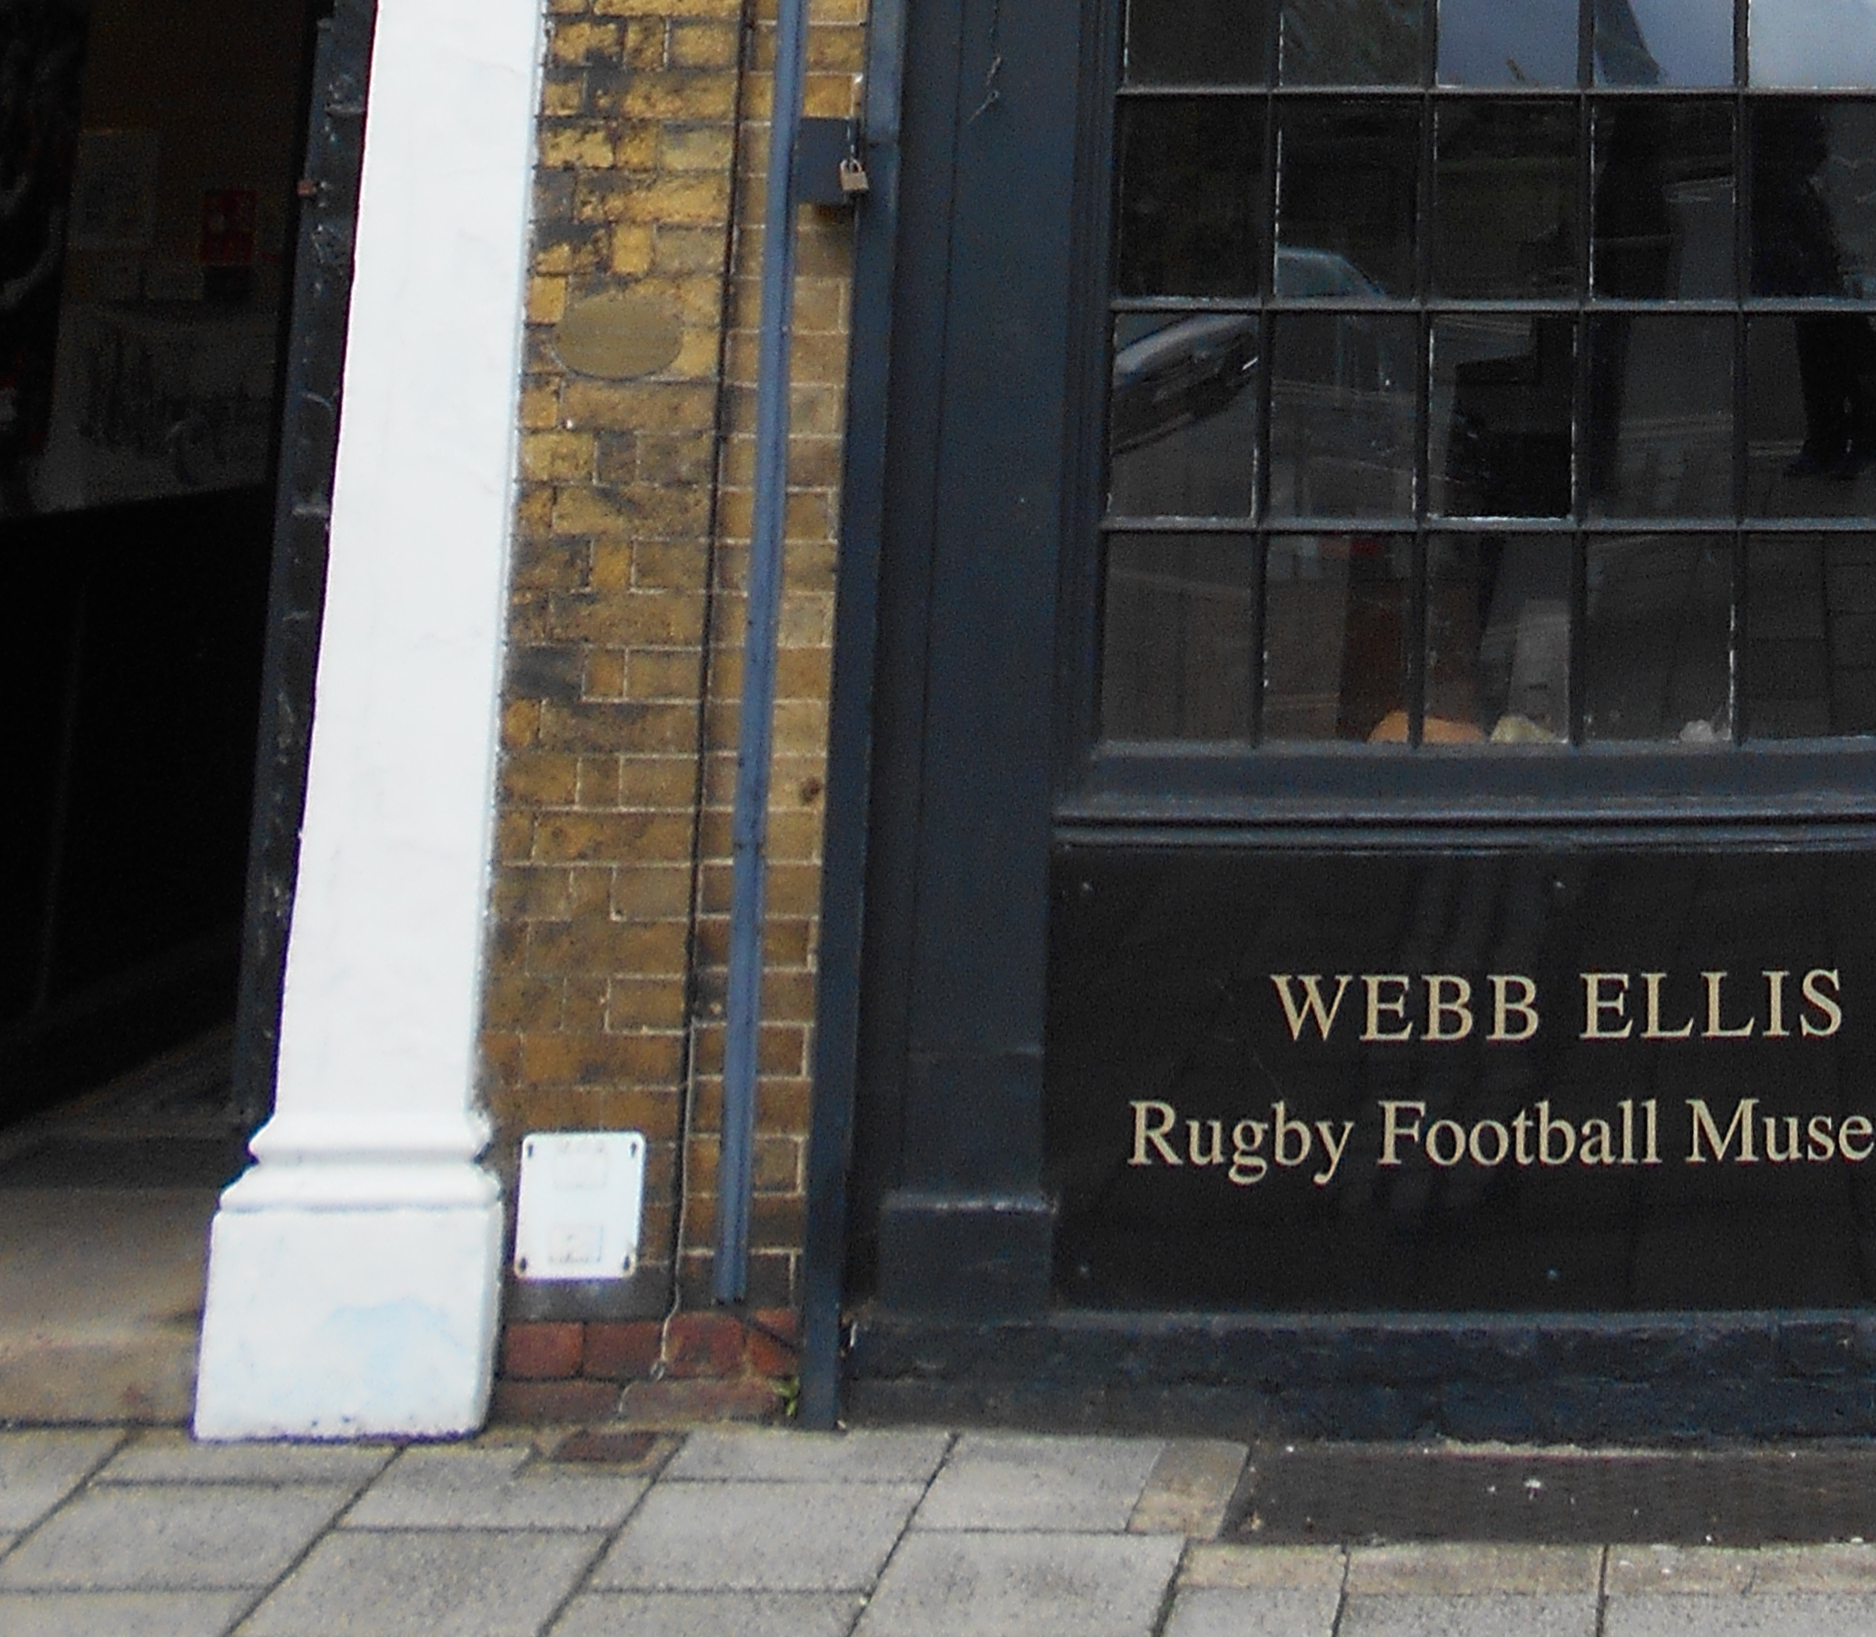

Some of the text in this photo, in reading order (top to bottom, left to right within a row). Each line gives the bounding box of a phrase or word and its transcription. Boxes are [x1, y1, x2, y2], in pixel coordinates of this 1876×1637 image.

[1270, 968, 1843, 1042] WEBB ELLIS
[1127, 1100, 1355, 1185] Rugby
[1376, 1098, 1663, 1167] Football
